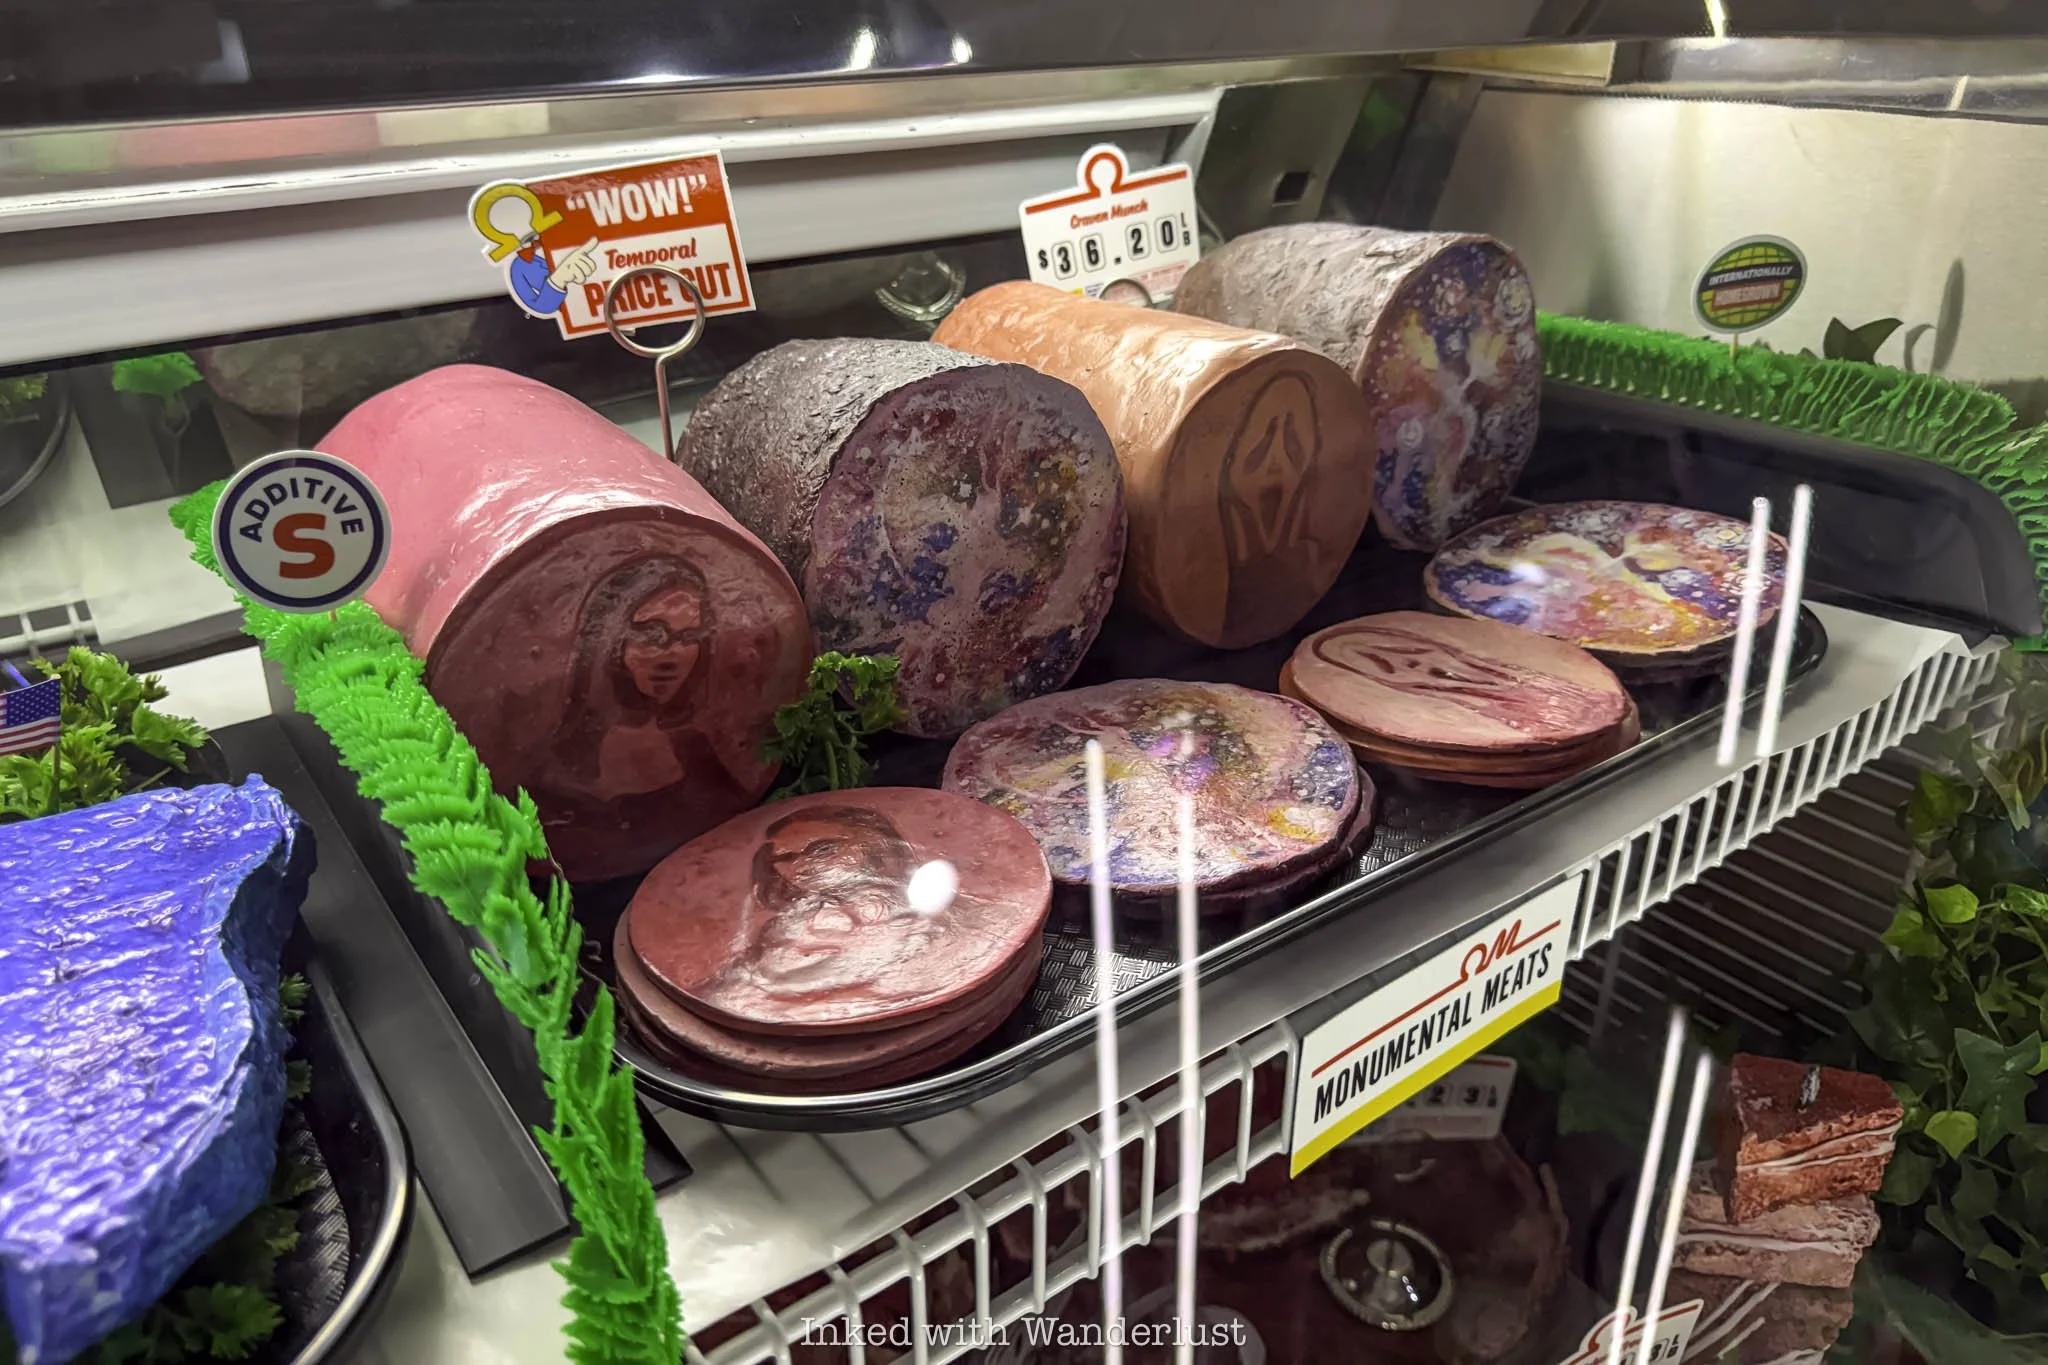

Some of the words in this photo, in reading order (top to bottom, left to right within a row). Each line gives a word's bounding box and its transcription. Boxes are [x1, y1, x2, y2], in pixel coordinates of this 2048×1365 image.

[1110, 198, 1149, 220] Munch
[605, 237, 697, 270] Temporal
[1708, 265, 1793, 286] INTERNATIONALLY
[584, 272, 673, 317] PRICE
[677, 262, 731, 303] CUT
[239, 477, 365, 543] ADDITIVE
[273, 512, 336, 579] S
[1314, 991, 1472, 1124] MONUMENTAL
[1481, 942, 1552, 1015] MEATS
